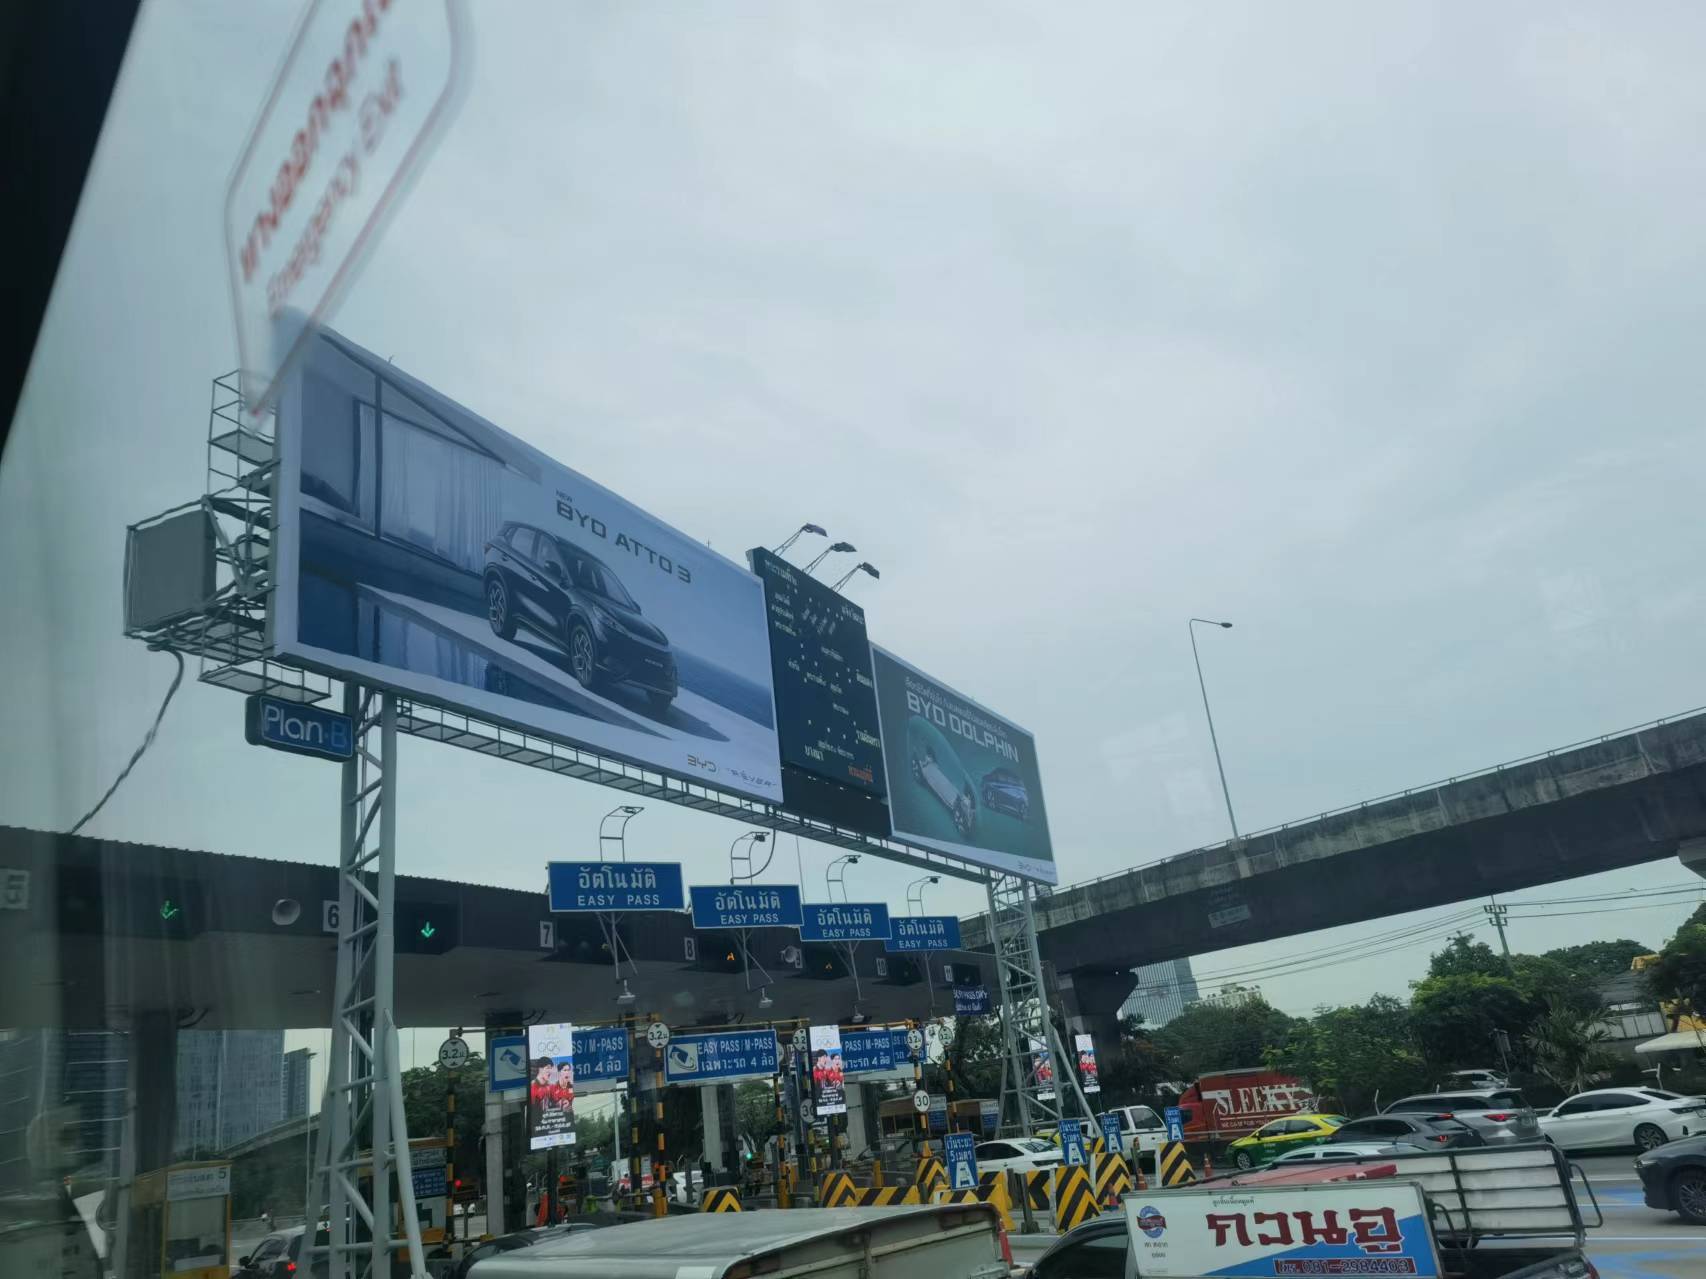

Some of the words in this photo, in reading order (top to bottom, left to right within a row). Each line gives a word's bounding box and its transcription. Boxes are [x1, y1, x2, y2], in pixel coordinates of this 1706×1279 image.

[557, 499, 606, 538] BYD
[615, 532, 672, 574] ATTO
[678, 564, 691, 584] 3
[264, 704, 323, 744] Plan
[906, 690, 946, 727] BYD
[949, 713, 1018, 762] DOLPHIN
[578, 865, 656, 889] อัตโนมัติ
[577, 895, 616, 906] EASY
[627, 894, 660, 905] PASS
[715, 890, 781, 910] อัตโนมัติ
[328, 904, 340, 929] 6
[720, 914, 747, 924] EASY
[754, 913, 779, 923] PASS
[817, 907, 873, 926] อัตโนมัติ
[542, 925, 550, 945] 7
[823, 929, 845, 938] EASY
[850, 928, 871, 938] PASS
[898, 919, 945, 936] อัตโนมัติ
[899, 940, 921, 949] EASY
[928, 939, 948, 948] PASS
[572, 1039, 583, 1055] SS
[698, 1041, 718, 1055] EASY
[721, 1039, 740, 1054] PASS
[594, 1061, 603, 1073] 4
[750, 1057, 757, 1068] 4
[917, 1096, 928, 1107] 30
[1206, 1207, 1404, 1254] กวนอู
